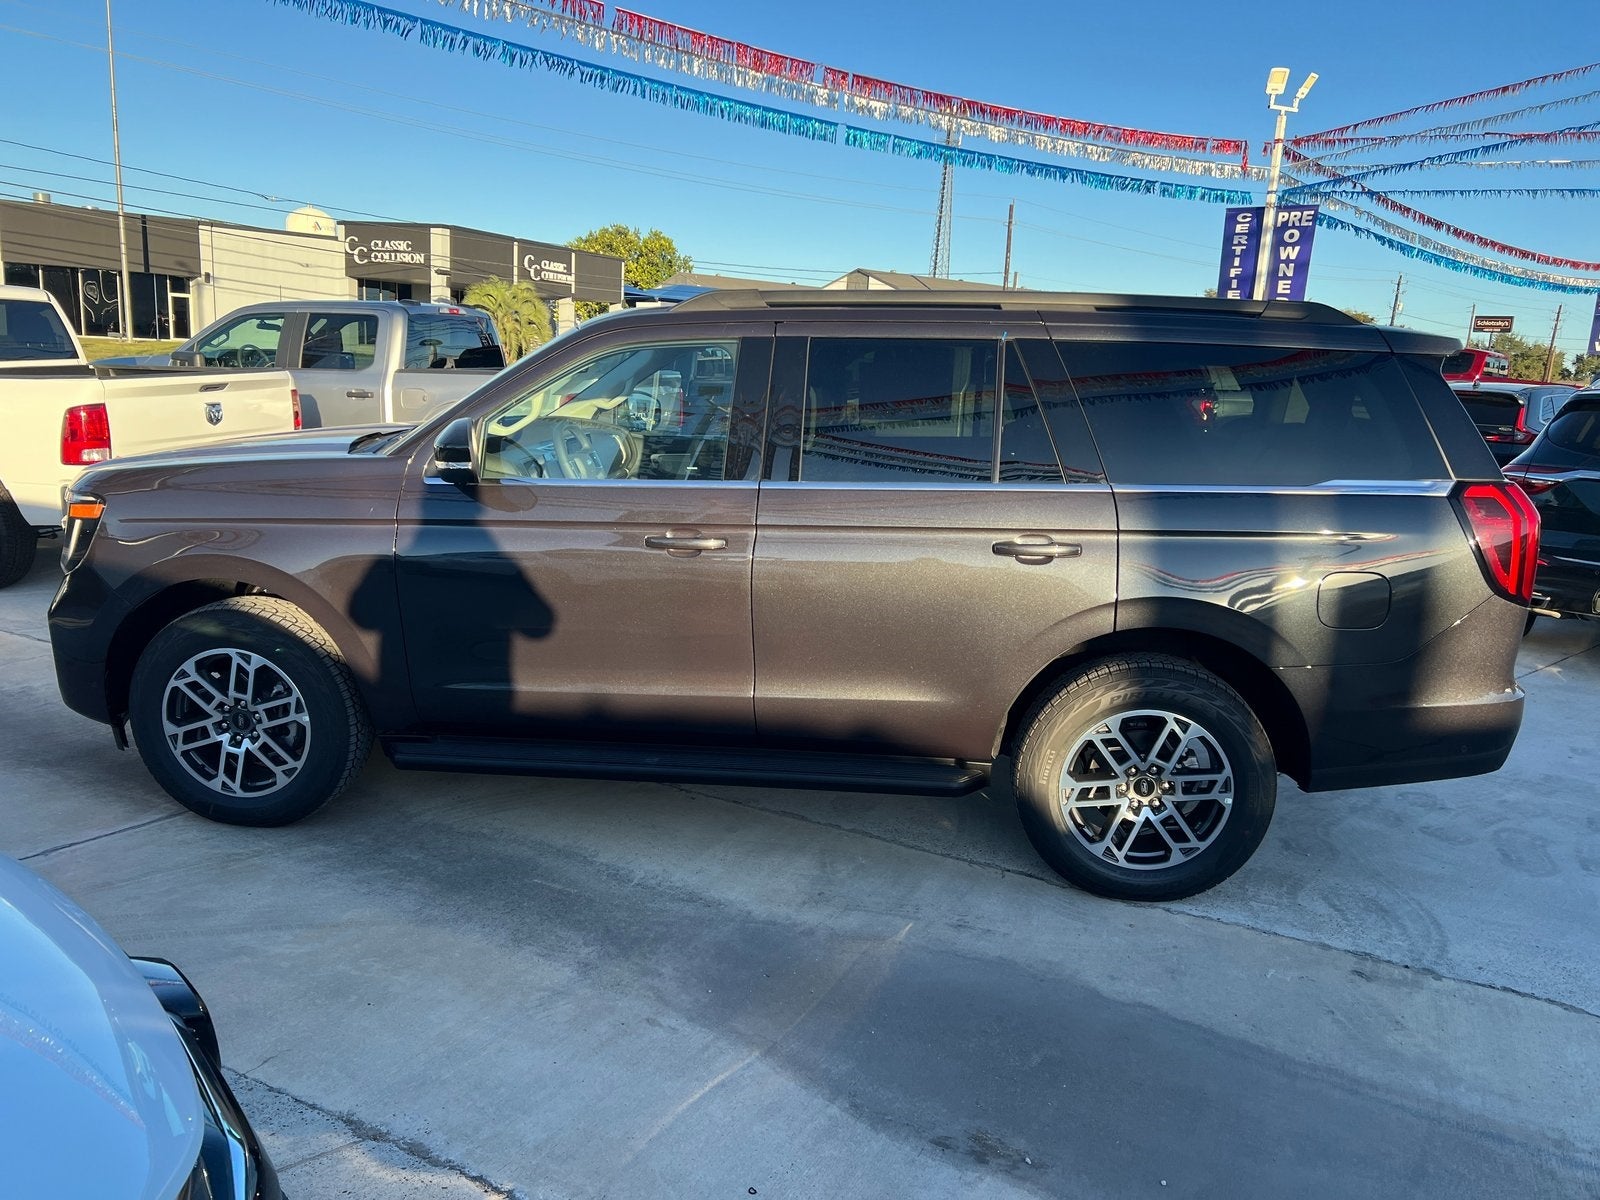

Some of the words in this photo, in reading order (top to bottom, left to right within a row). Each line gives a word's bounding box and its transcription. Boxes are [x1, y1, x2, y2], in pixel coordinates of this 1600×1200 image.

[1276, 210, 1315, 227] PRE
[370, 239, 412, 251] CLASSIC
[370, 251, 425, 264] COLLISION
[540, 260, 567, 273] CLASSIC
